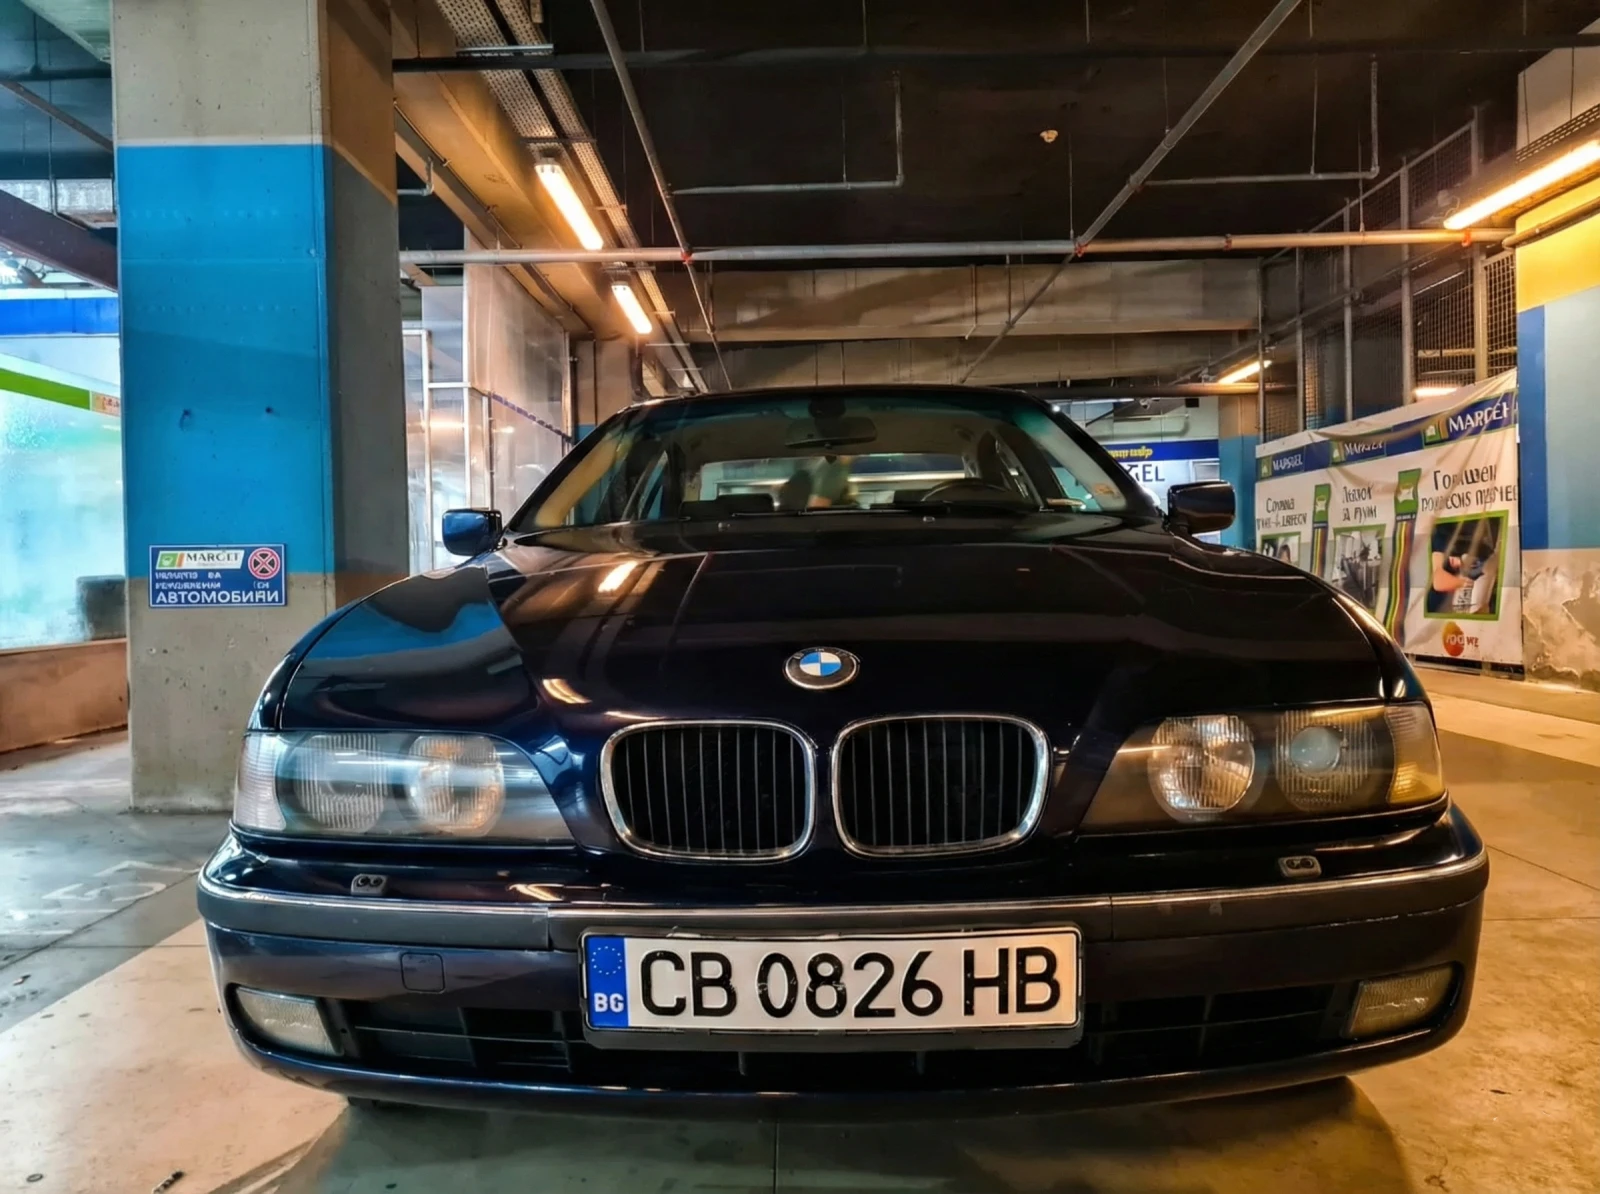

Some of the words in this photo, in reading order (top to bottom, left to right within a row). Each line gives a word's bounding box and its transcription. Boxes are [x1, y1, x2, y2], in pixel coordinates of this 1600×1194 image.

[593, 992, 625, 1013] BG
[639, 949, 738, 1018] CB
[755, 949, 944, 1019] 0826
[962, 946, 1063, 1017] HB
